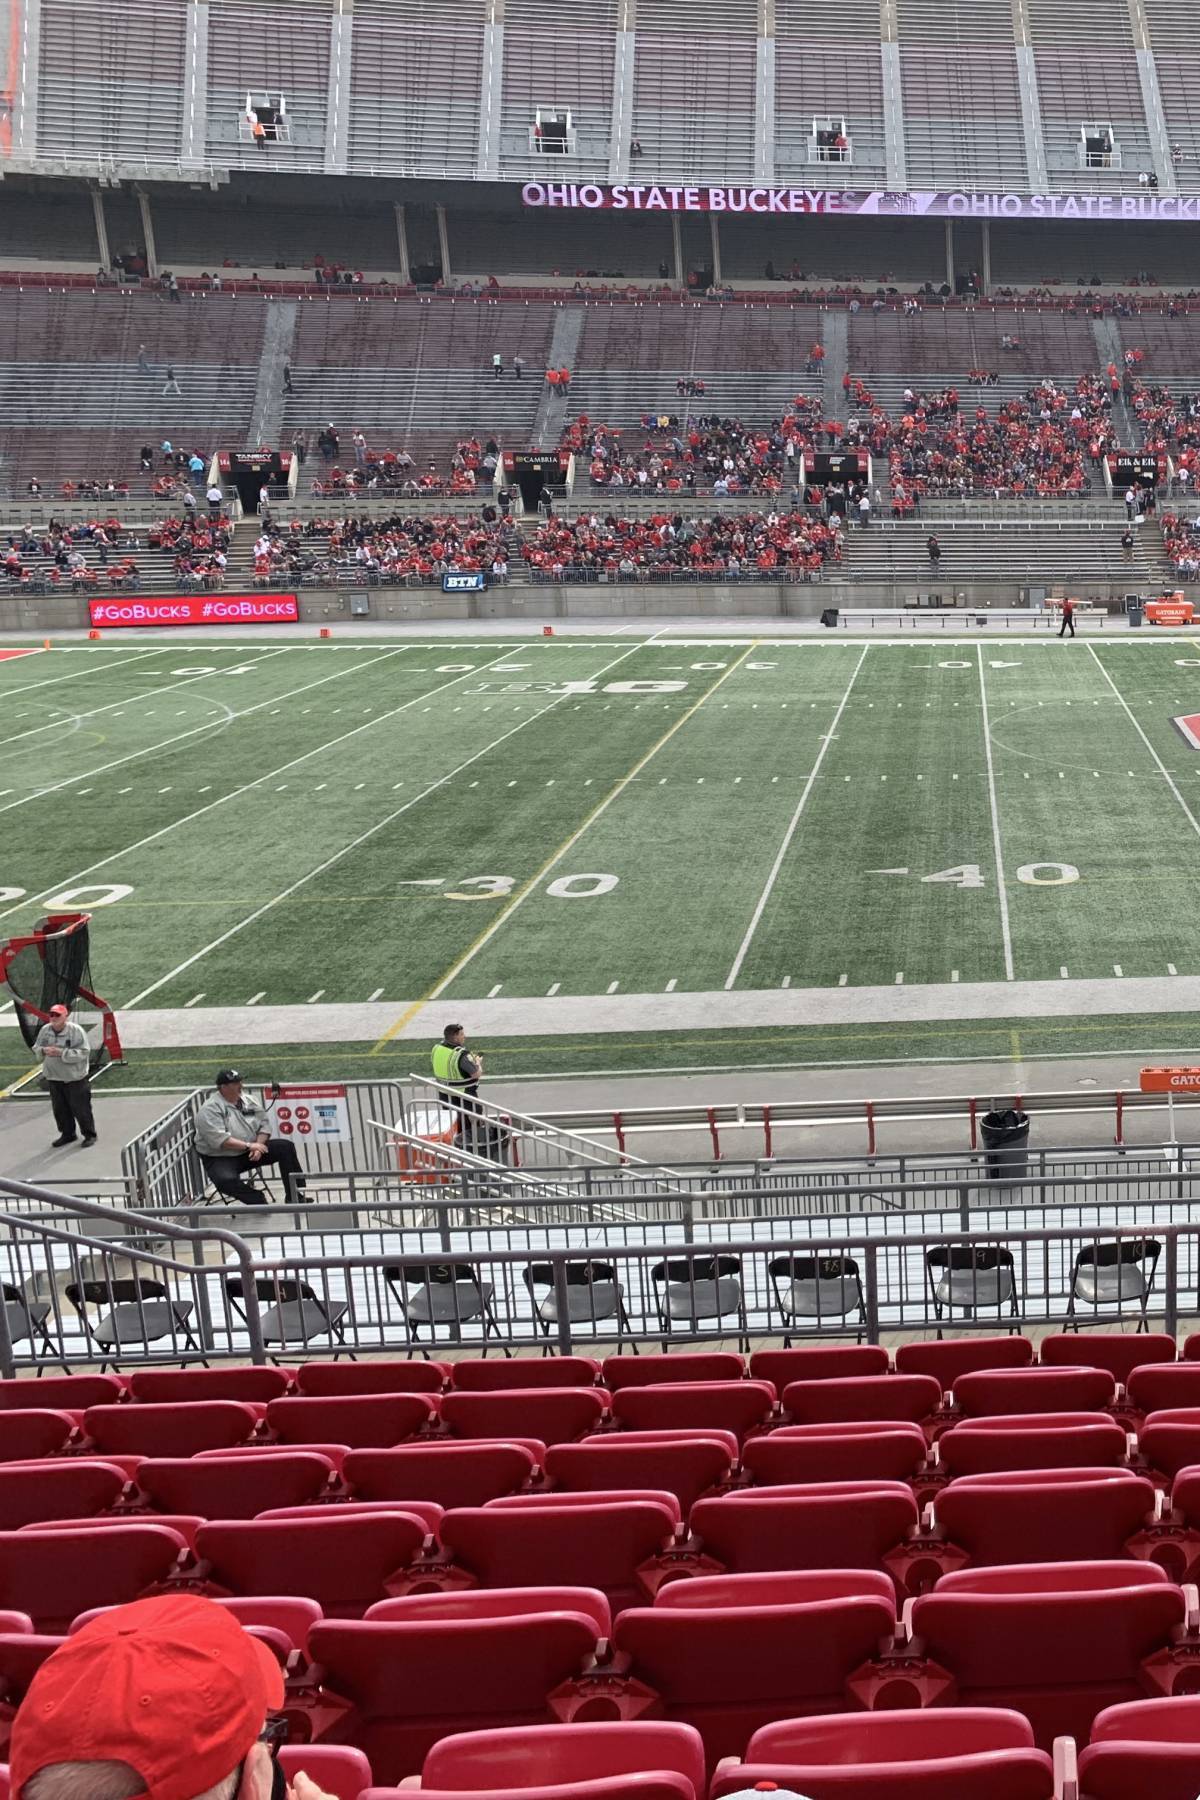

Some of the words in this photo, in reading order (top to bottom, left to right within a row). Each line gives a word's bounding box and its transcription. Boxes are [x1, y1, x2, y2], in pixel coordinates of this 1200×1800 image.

[522, 183, 602, 208] OHIO
[612, 187, 699, 210] STATE
[946, 194, 1020, 216] OHIO
[1031, 195, 1111, 217] STATE
[1118, 458, 1132, 466] Elk
[1133, 458, 1140, 466] &
[1141, 458, 1156, 466] Elk
[446, 576, 478, 588] BTN
[443, 873, 620, 901] 30
[921, 862, 1080, 888] 40
